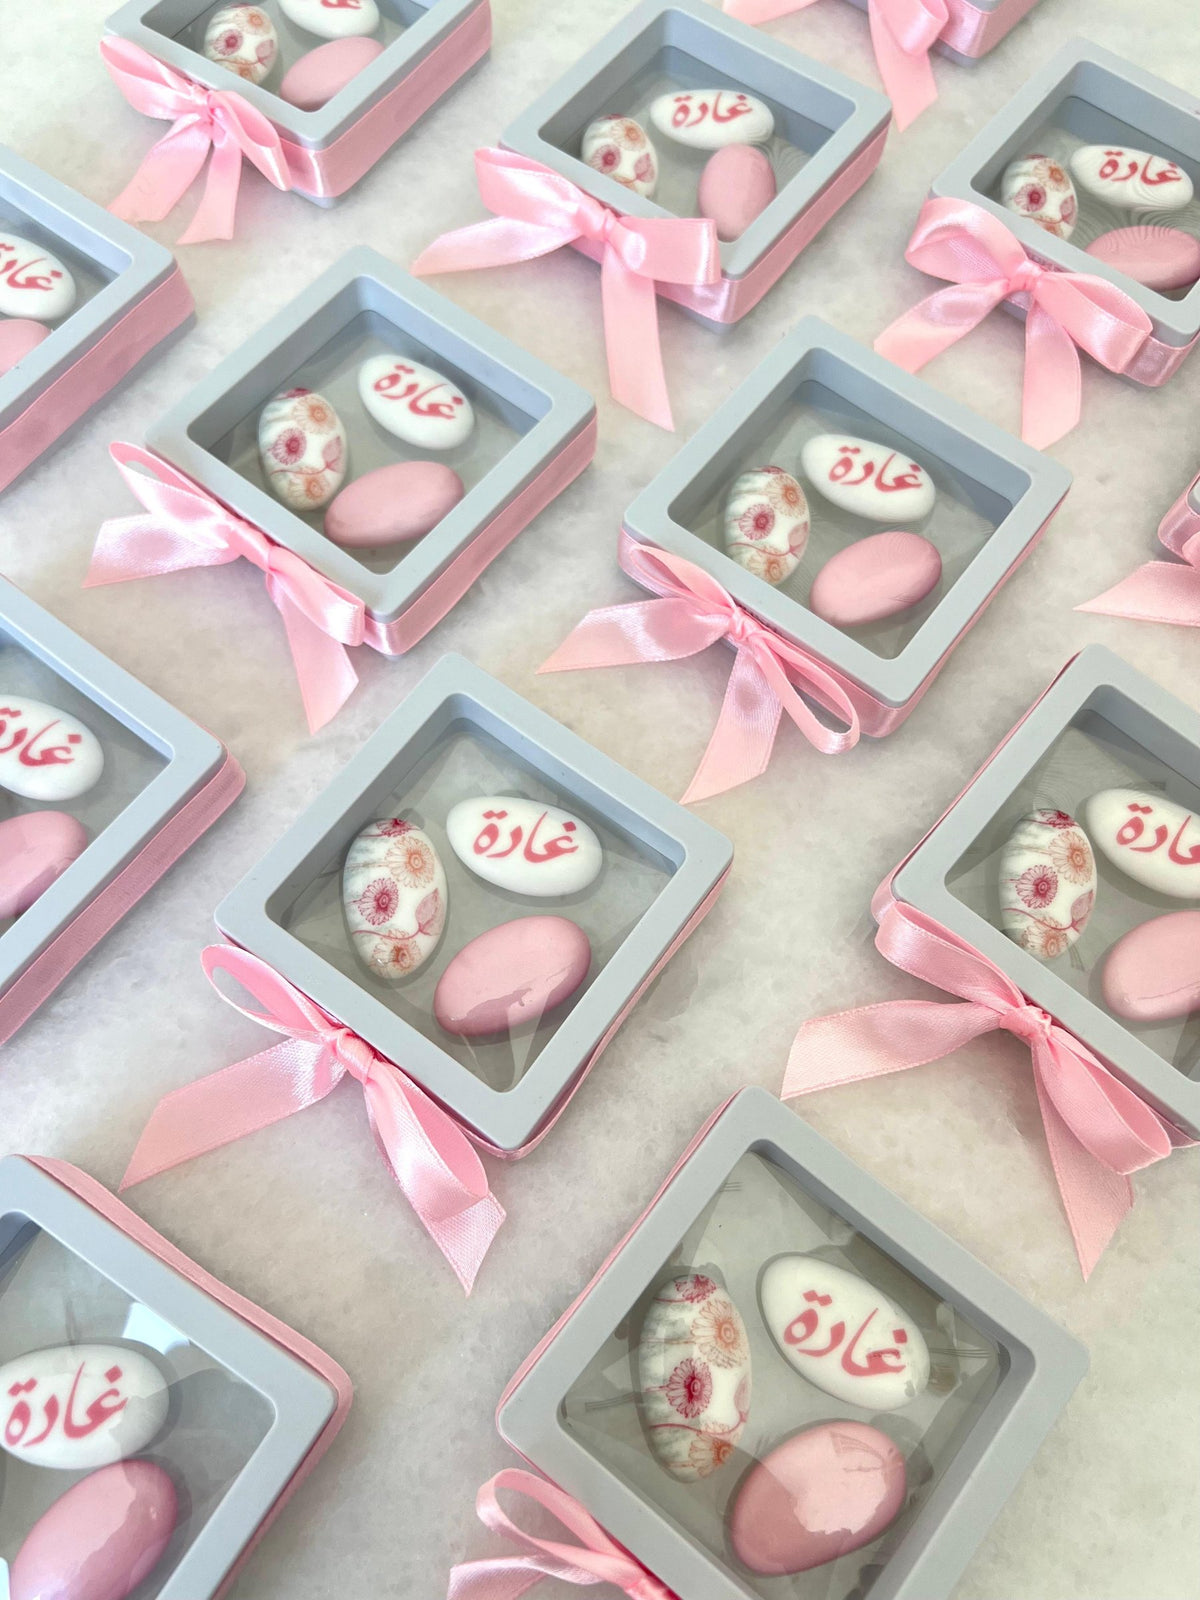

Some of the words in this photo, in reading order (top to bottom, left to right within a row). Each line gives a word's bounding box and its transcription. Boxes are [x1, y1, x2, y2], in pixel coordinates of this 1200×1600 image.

[673, 93, 752, 127] غادة
[1099, 150, 1182, 186] غادة
[0, 243, 63, 291] غاد
[374, 364, 463, 420] غادة
[829, 446, 922, 493] غادة
[473, 811, 578, 864] غادة
[1116, 803, 1200, 866] ادة
[784, 1290, 907, 1377] غادة
[5, 1362, 127, 1447] غادة
